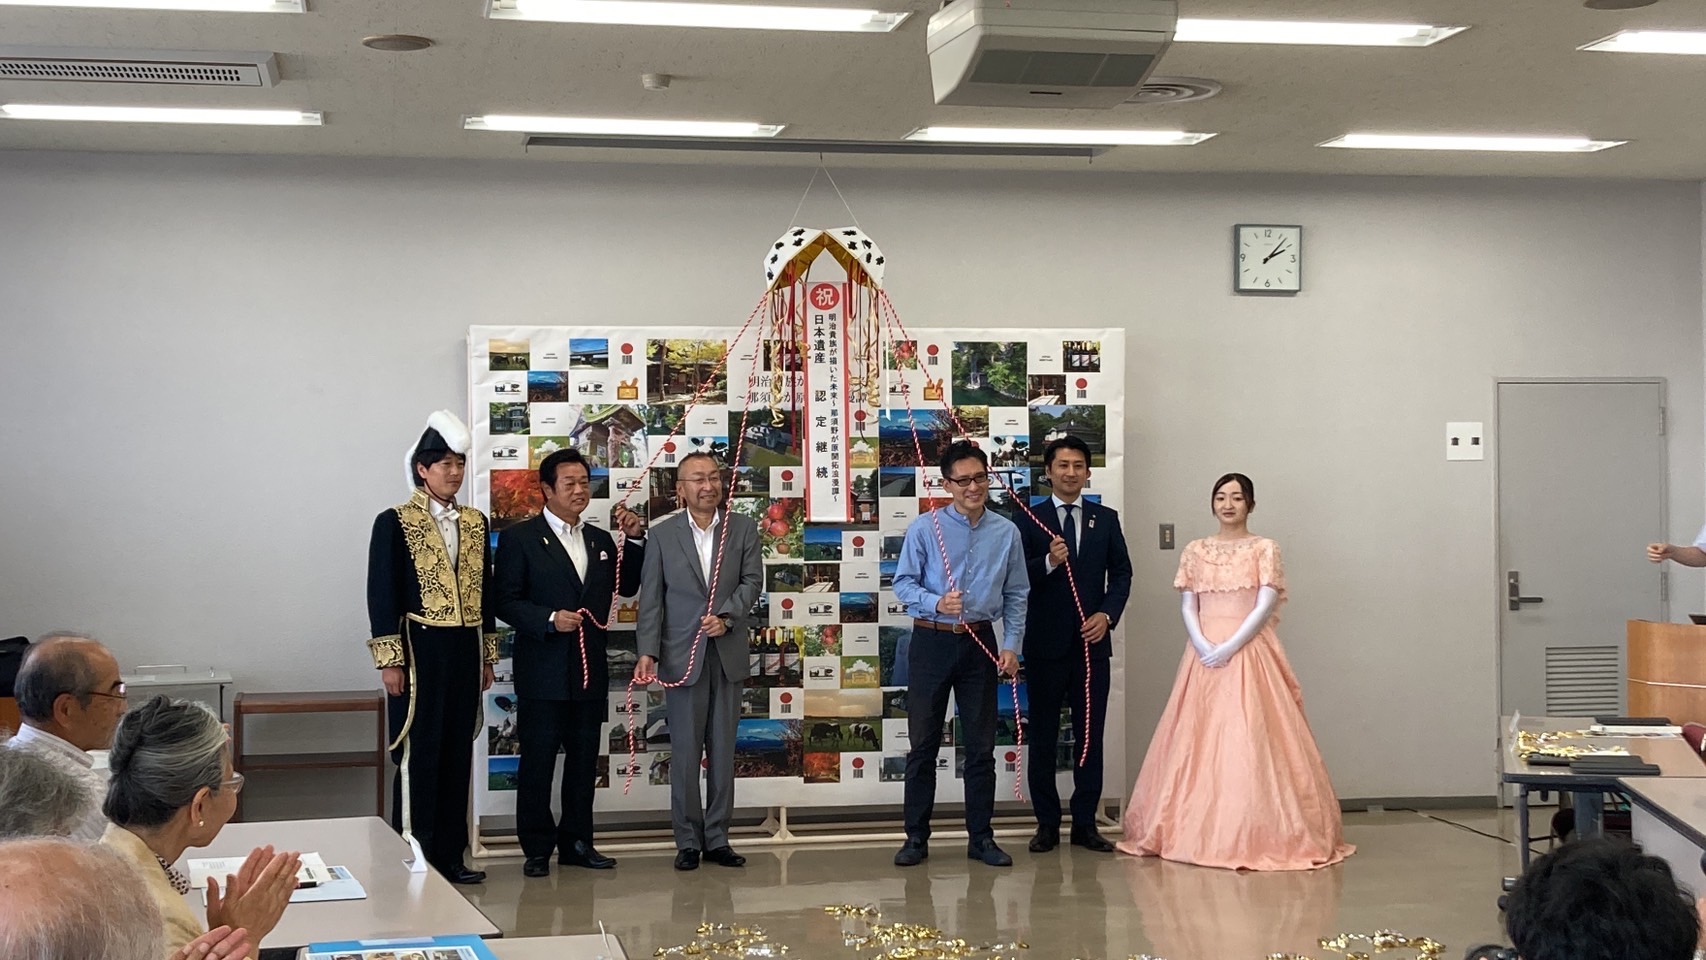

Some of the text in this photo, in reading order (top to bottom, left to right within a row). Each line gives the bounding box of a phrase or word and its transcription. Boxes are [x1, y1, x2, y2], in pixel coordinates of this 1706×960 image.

[1264, 229, 1272, 238] 12
[1240, 253, 1246, 262] 9
[1290, 254, 1296, 263] 3
[1264, 279, 1271, 288] 6
[815, 287, 835, 306] 祝
[813, 314, 828, 479] 日本遺産 認定継続
